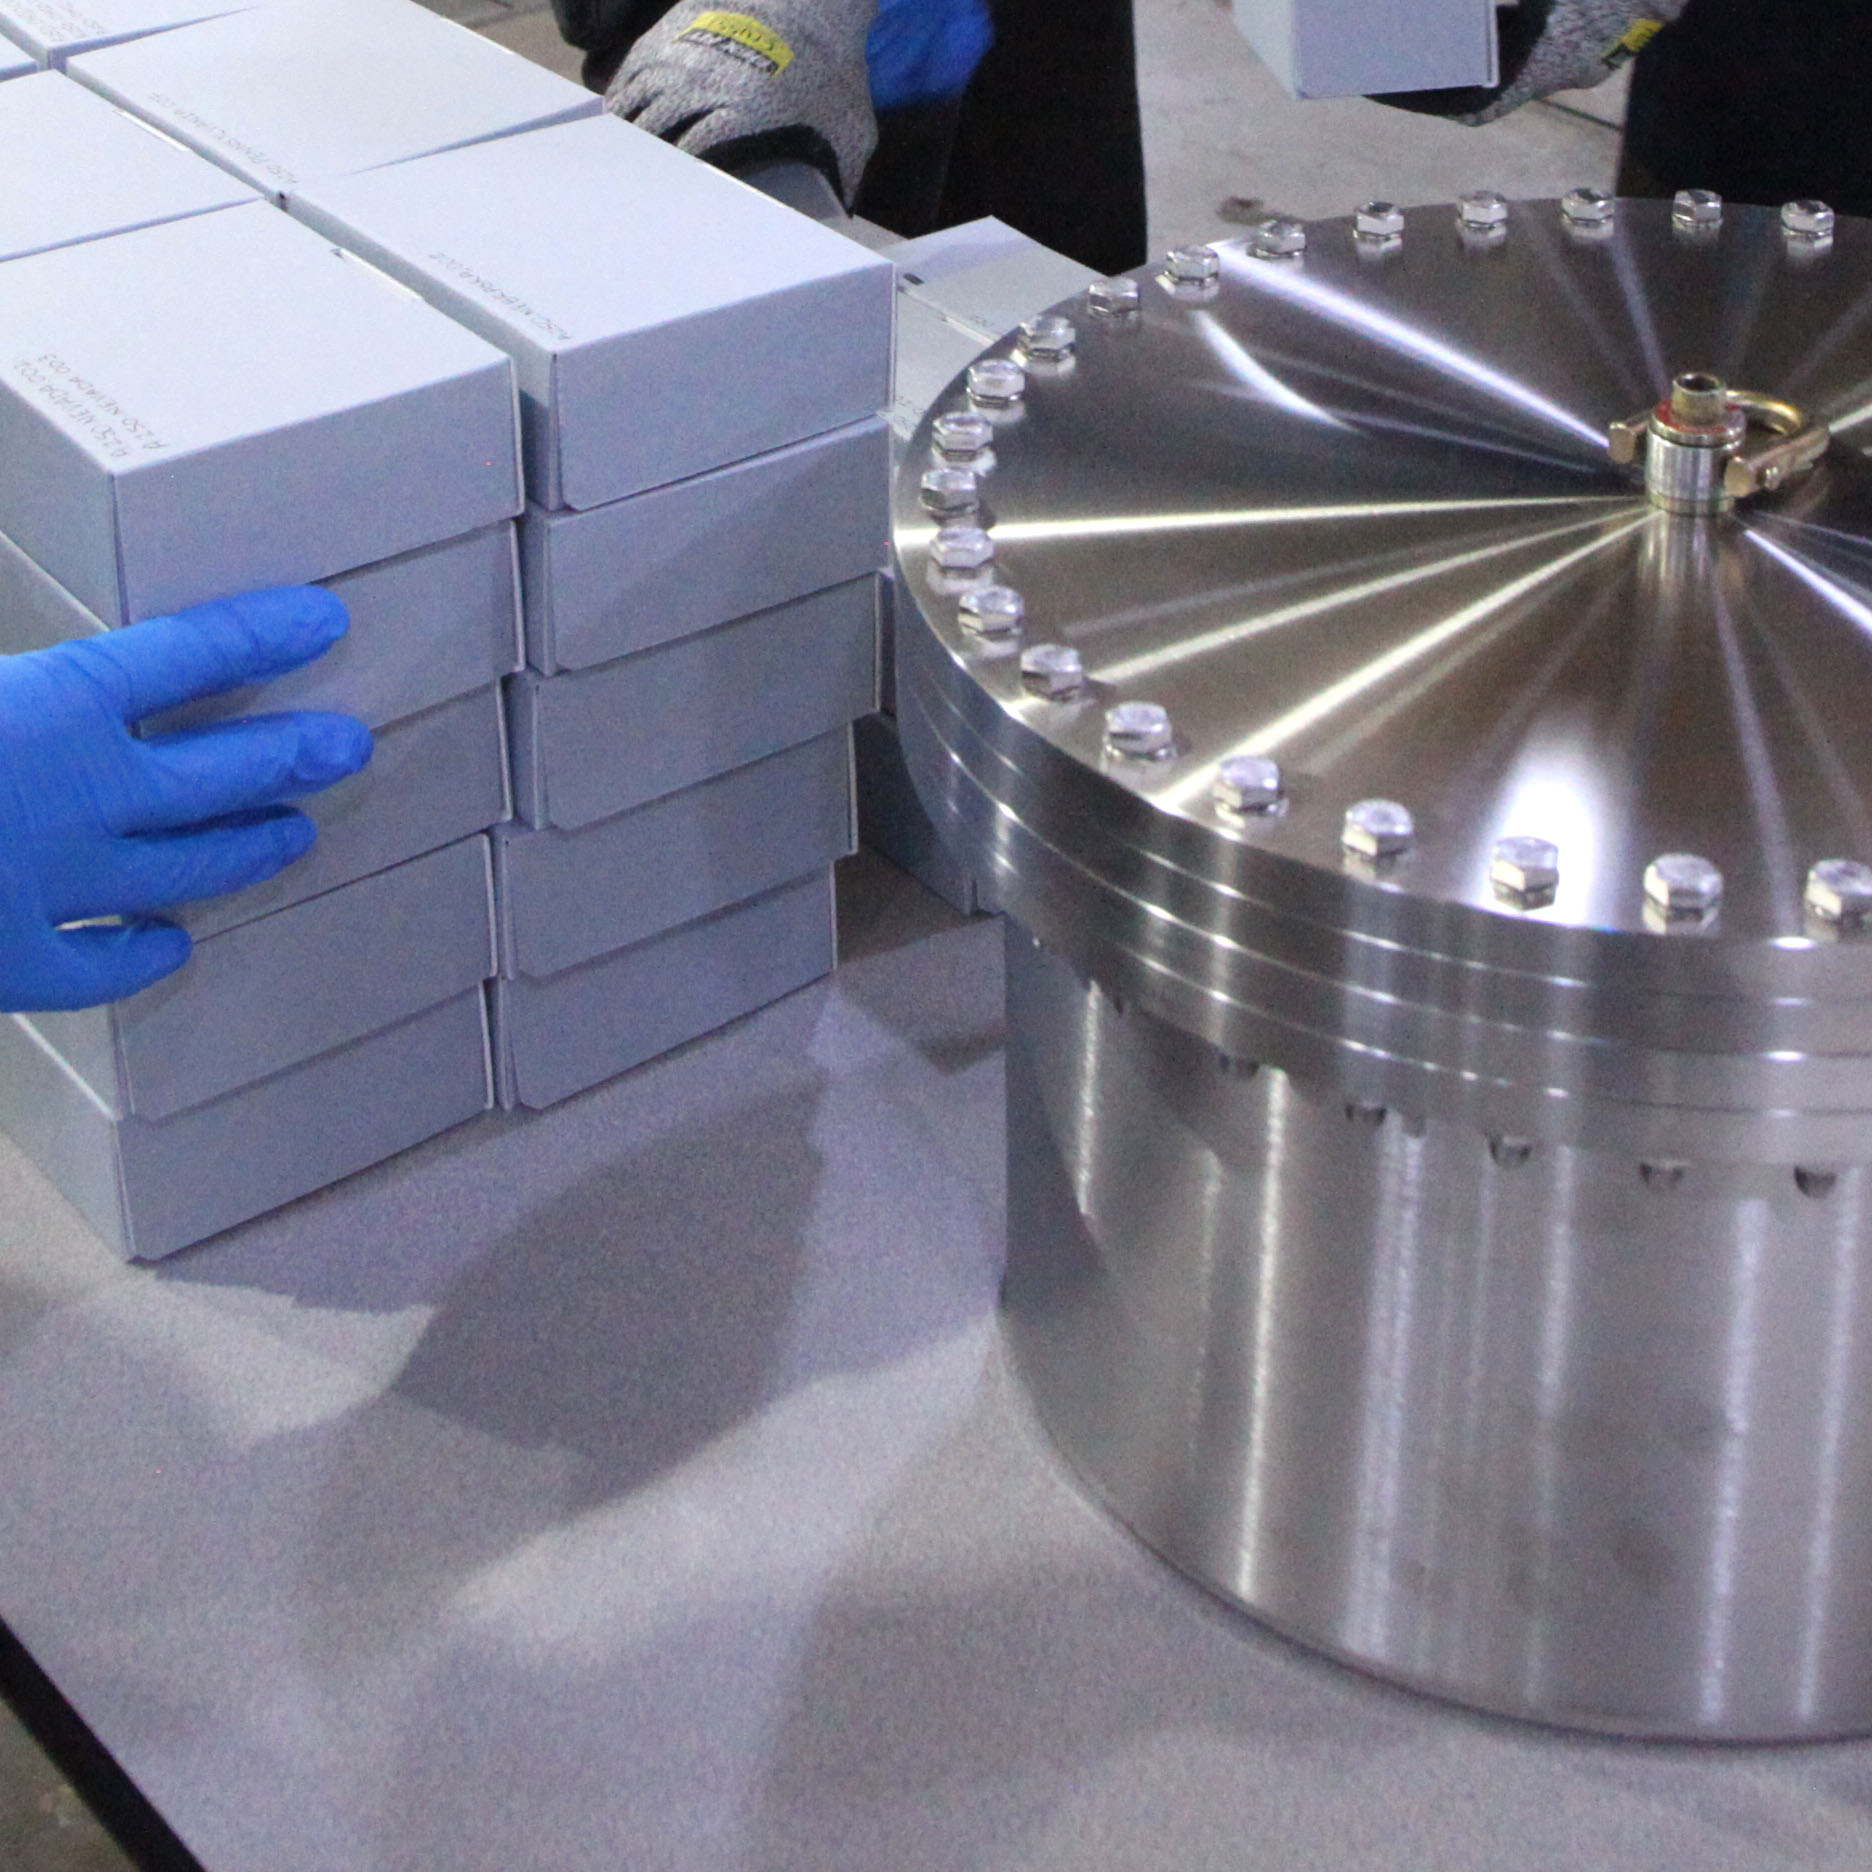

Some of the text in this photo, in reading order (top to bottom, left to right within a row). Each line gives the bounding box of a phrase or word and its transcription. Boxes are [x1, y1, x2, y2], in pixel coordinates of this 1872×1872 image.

[39, 383, 96, 425] NEVADA
[68, 375, 122, 416] NEVADA
[120, 416, 168, 449] A250
